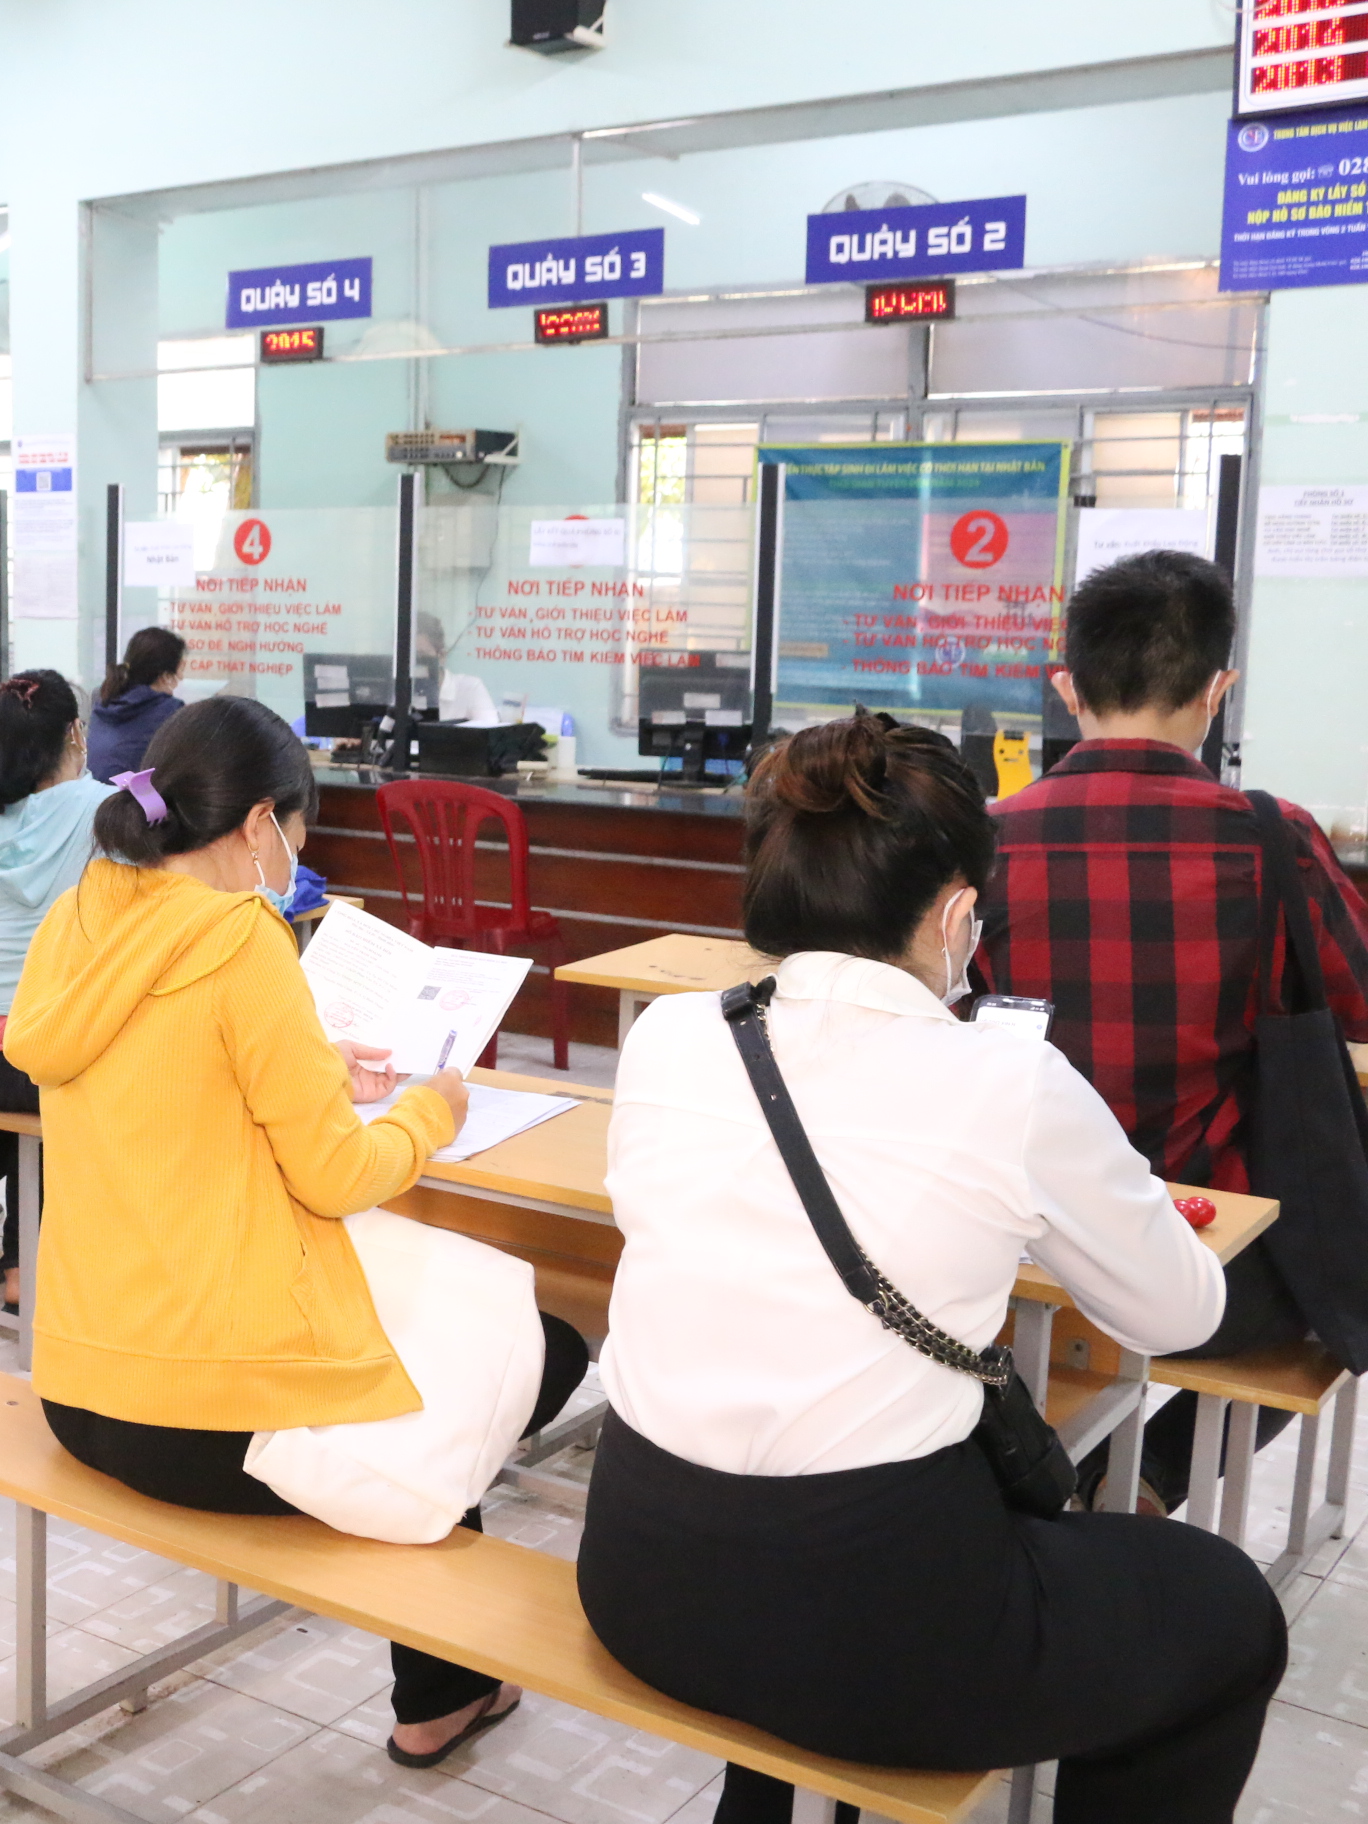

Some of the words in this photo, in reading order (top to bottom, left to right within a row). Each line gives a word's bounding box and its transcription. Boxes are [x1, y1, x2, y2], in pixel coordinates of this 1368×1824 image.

[1238, 172, 1259, 186] Vui
[1262, 171, 1289, 185] lòng
[1350, 180, 1367, 198] SỐ
[1247, 209, 1270, 226] NỘP
[1272, 205, 1289, 222] HỒ
[1291, 206, 1307, 221] SƠ
[1334, 199, 1363, 217] HIỂM
[927, 216, 972, 256] SỐ
[983, 221, 1006, 252] 2
[584, 246, 621, 283] SỐ
[630, 251, 646, 278] 3
[306, 272, 337, 307] SỐ
[344, 277, 360, 302] 4
[242, 524, 264, 560] 4
[963, 518, 997, 562] 2
[227, 577, 259, 592] TIẾP
[264, 577, 307, 596] NHẬN
[507, 580, 540, 595] NƠI
[546, 580, 585, 596] TIẾP
[893, 583, 933, 600] NƠI
[941, 583, 991, 601] TIẾP
[285, 603, 312, 618] VIỆC
[315, 602, 341, 615] LÀM
[476, 606, 495, 618] TƯ
[535, 605, 565, 620] GIỚI
[571, 608, 613, 624] THIỆU
[656, 607, 688, 622] LÀM
[476, 625, 495, 638] TƯ
[500, 625, 526, 639] VẤN
[556, 627, 586, 644] TRỢ
[590, 628, 622, 645] HỌC
[626, 628, 668, 644] NGHỀ
[1043, 636, 1067, 652] NG
[475, 645, 523, 661] THÔNG
[527, 646, 557, 662] BÁO
